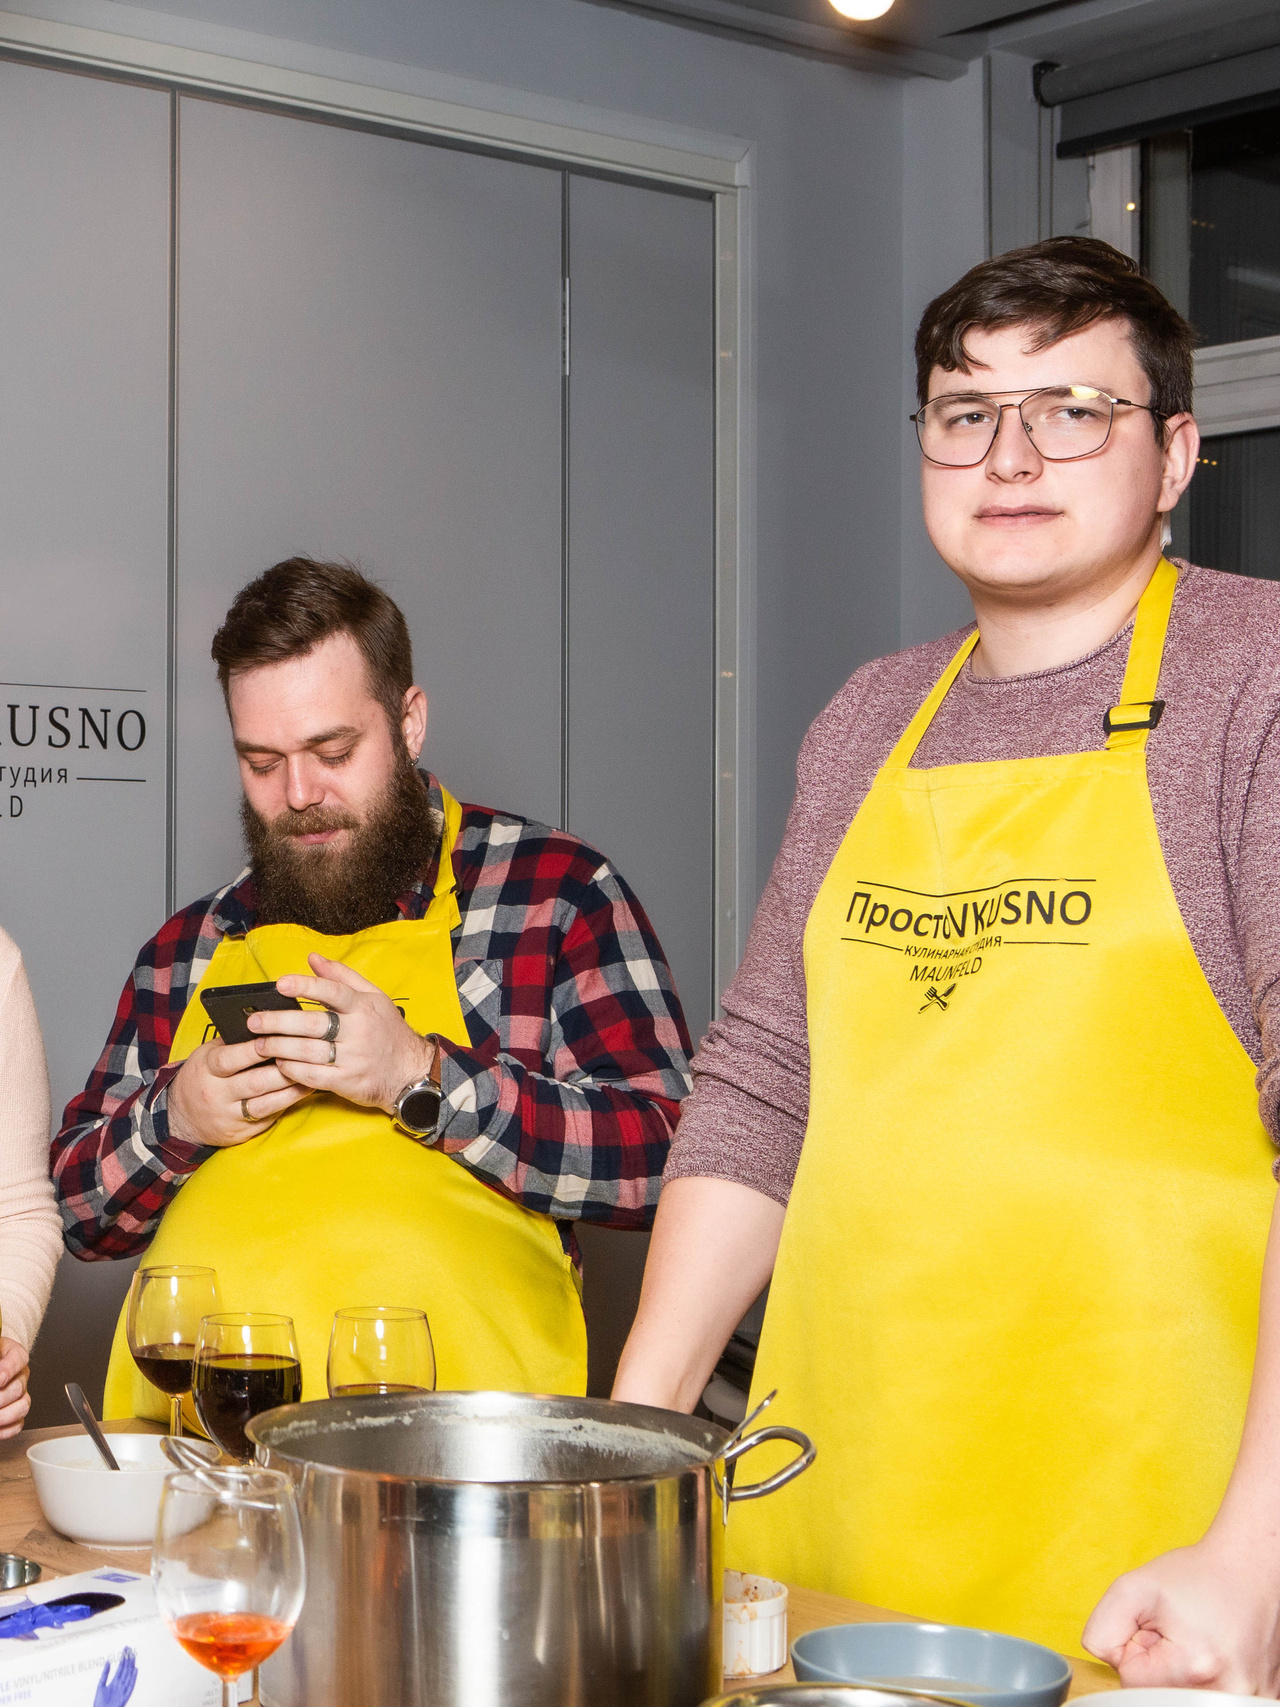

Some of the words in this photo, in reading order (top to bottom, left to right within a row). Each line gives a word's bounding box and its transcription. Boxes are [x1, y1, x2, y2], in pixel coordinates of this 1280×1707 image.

[846, 890, 1092, 940] ПростоVKUSNO
[909, 956, 983, 982] MAUNFELD
[77, 1656, 106, 1673] BLEND
[13, 1689, 33, 1702] FREE
